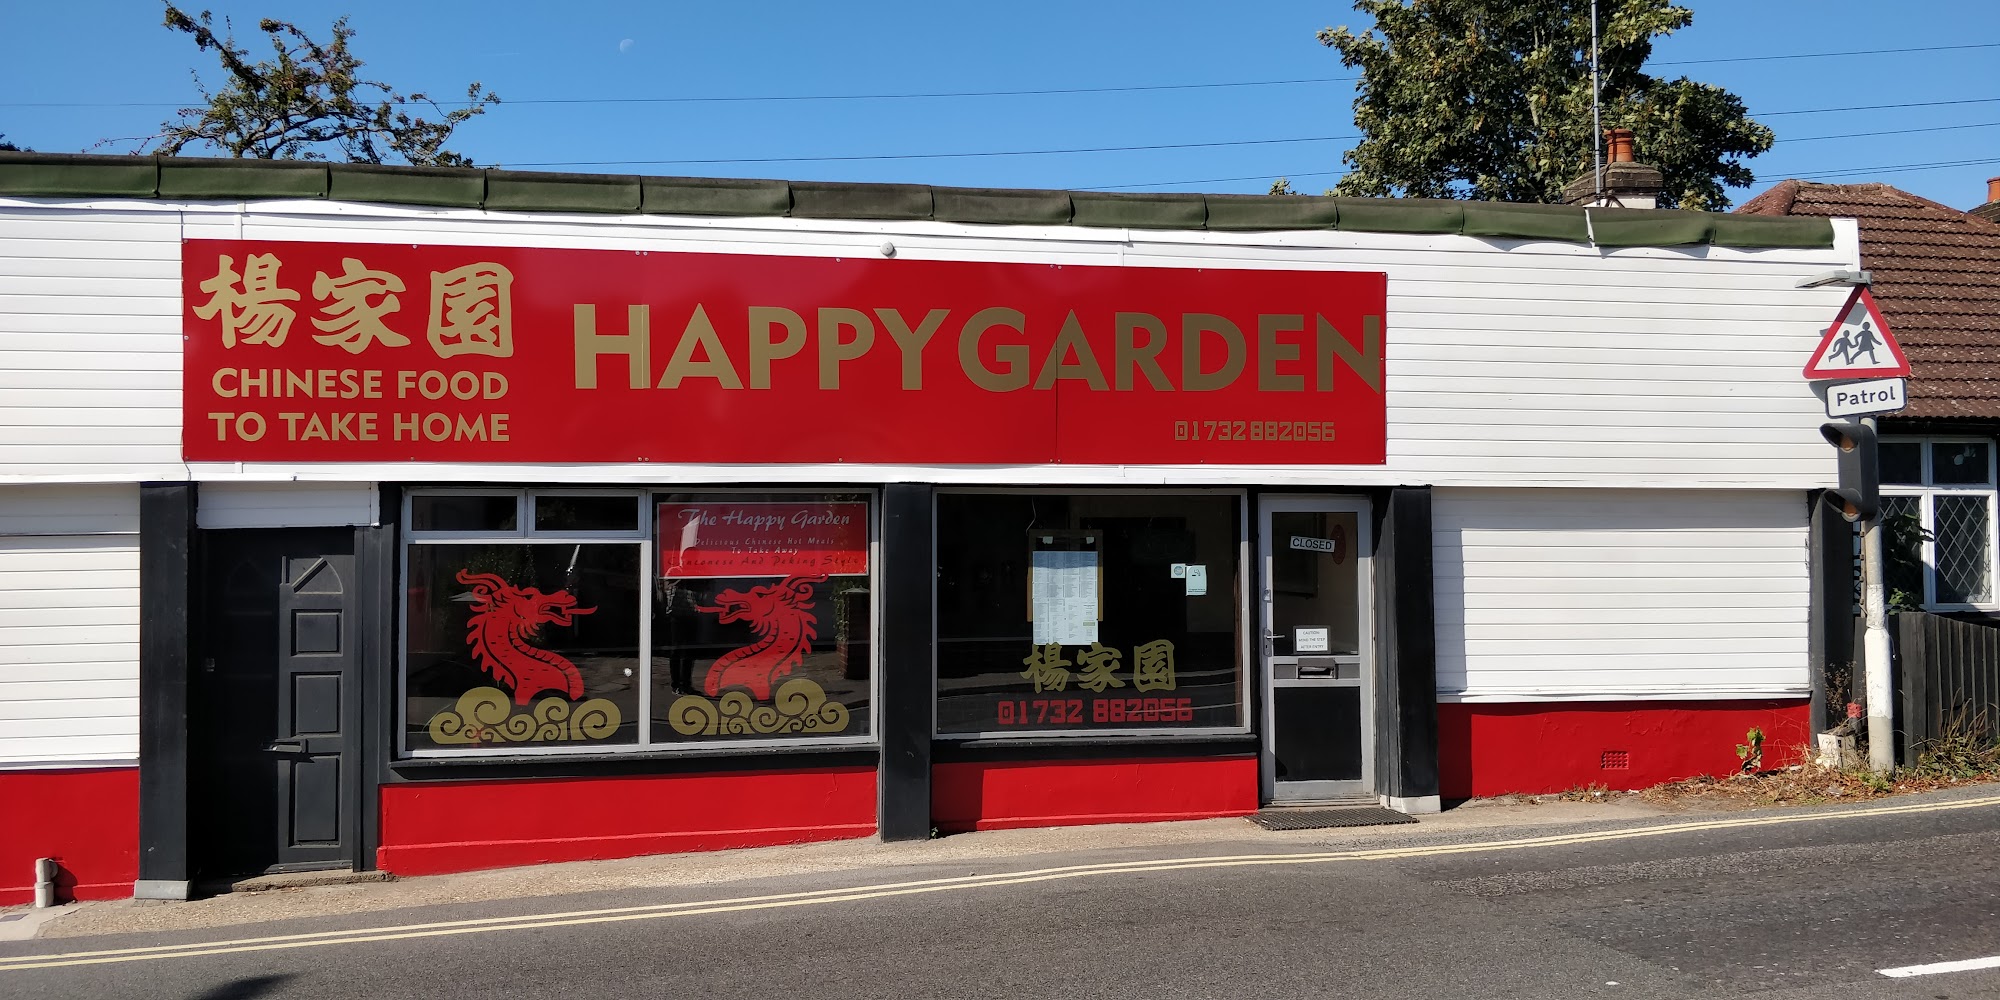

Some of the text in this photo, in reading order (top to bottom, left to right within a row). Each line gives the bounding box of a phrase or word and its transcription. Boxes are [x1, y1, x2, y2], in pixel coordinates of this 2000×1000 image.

[192, 252, 514, 359] 楊家園
[212, 367, 508, 400] CHINESE FOOD
[1836, 385, 1896, 407] Patrol
[208, 411, 509, 442] TO TAKE HOME
[677, 508, 850, 531] The Happy Garden
[694, 537, 835, 546] Delicious Chinese Hot Meals
[731, 546, 799, 556] To Take Away
[1292, 537, 1332, 550] CLOSED
[741, 556, 764, 565] And
[1020, 639, 1176, 694] 楊家園
[998, 698, 1193, 725] 01732 882056
